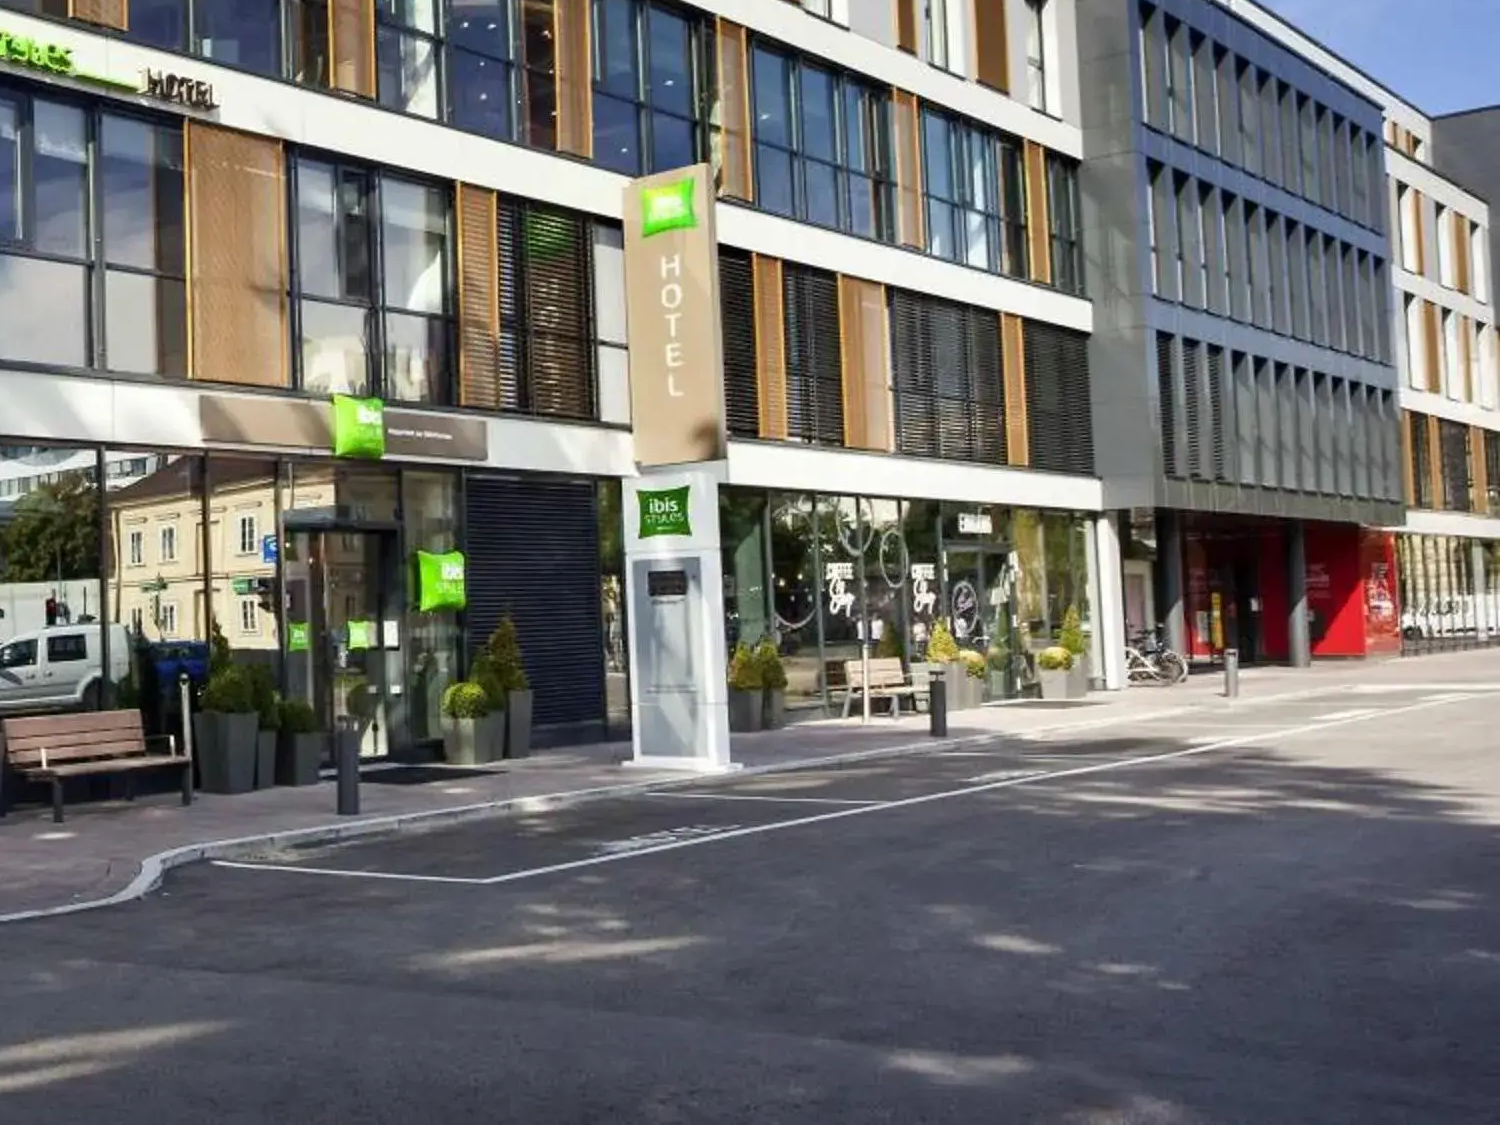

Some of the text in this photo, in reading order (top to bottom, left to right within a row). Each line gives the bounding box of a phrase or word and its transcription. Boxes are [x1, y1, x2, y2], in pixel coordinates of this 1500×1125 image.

[145, 67, 220, 110] HOTEL
[660, 254, 685, 397] HOTEL
[649, 497, 679, 514] ibis
